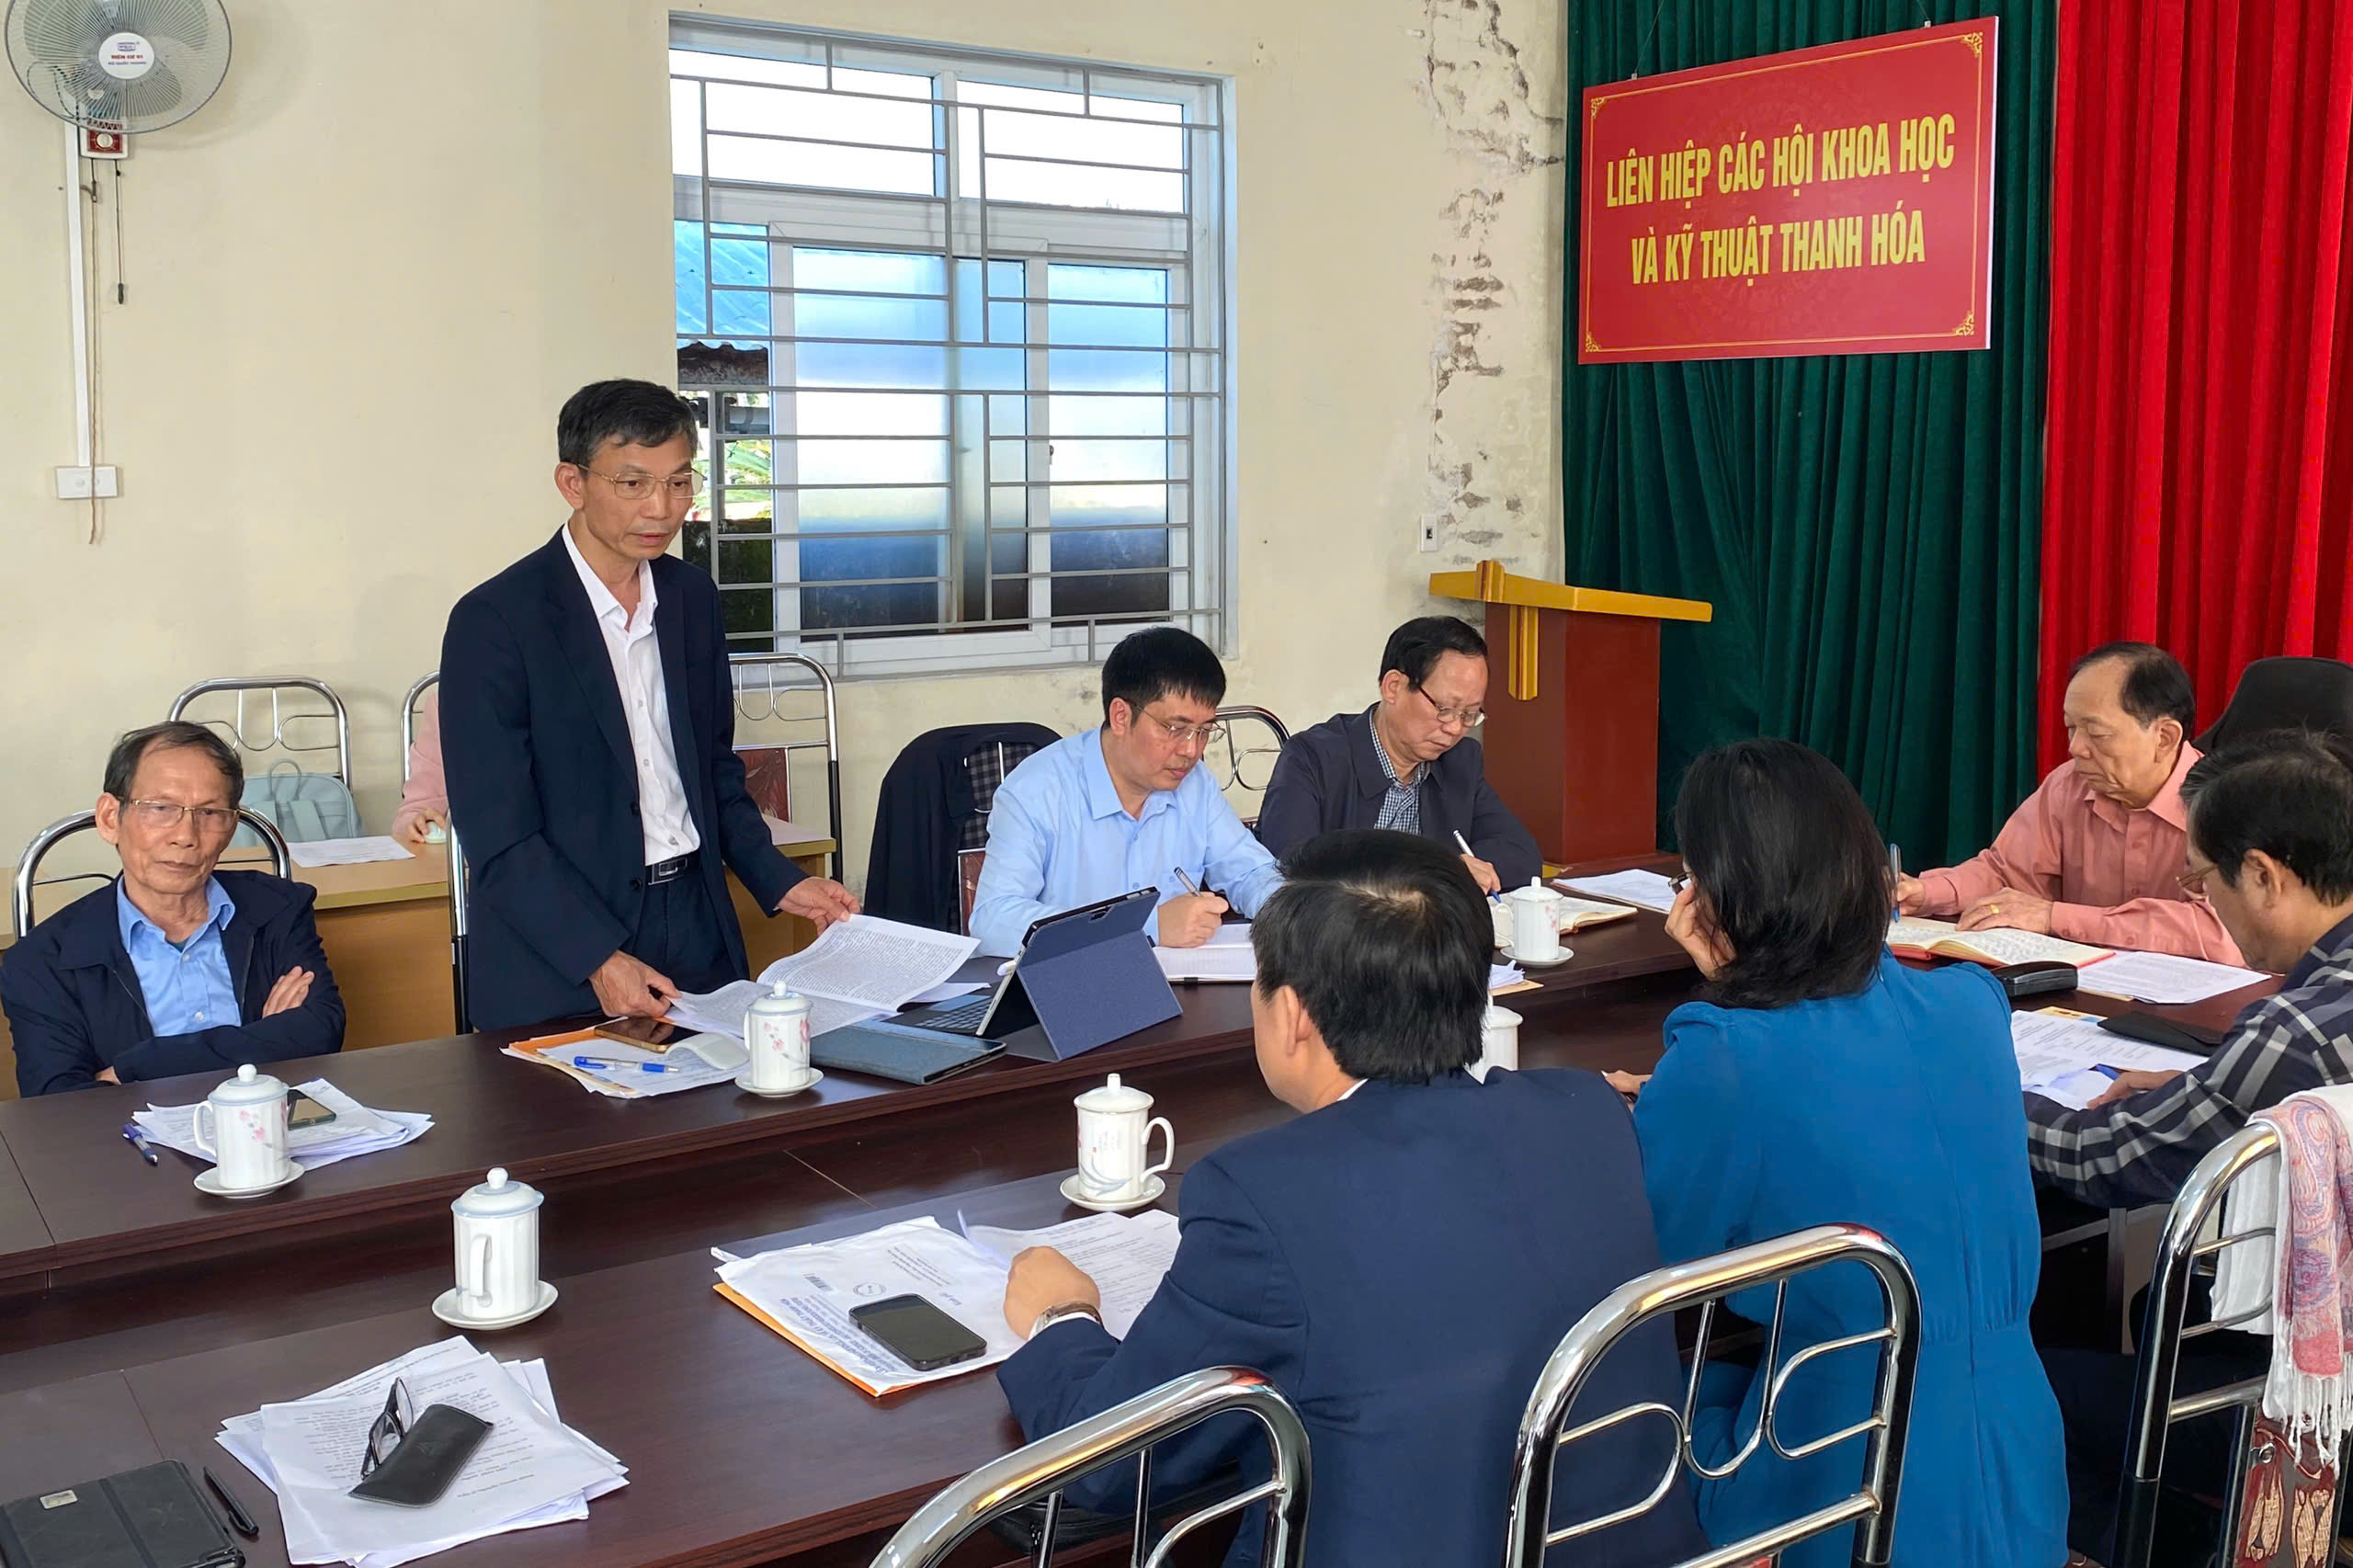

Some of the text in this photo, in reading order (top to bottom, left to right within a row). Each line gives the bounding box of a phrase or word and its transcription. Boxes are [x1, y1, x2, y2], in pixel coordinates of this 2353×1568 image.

[1607, 113, 1955, 210] LIÊN HIỆP CÁC HỘI KHOA HỌC
[1631, 200, 1926, 287] VÀ KỸ THUẬT THANH HÓA
